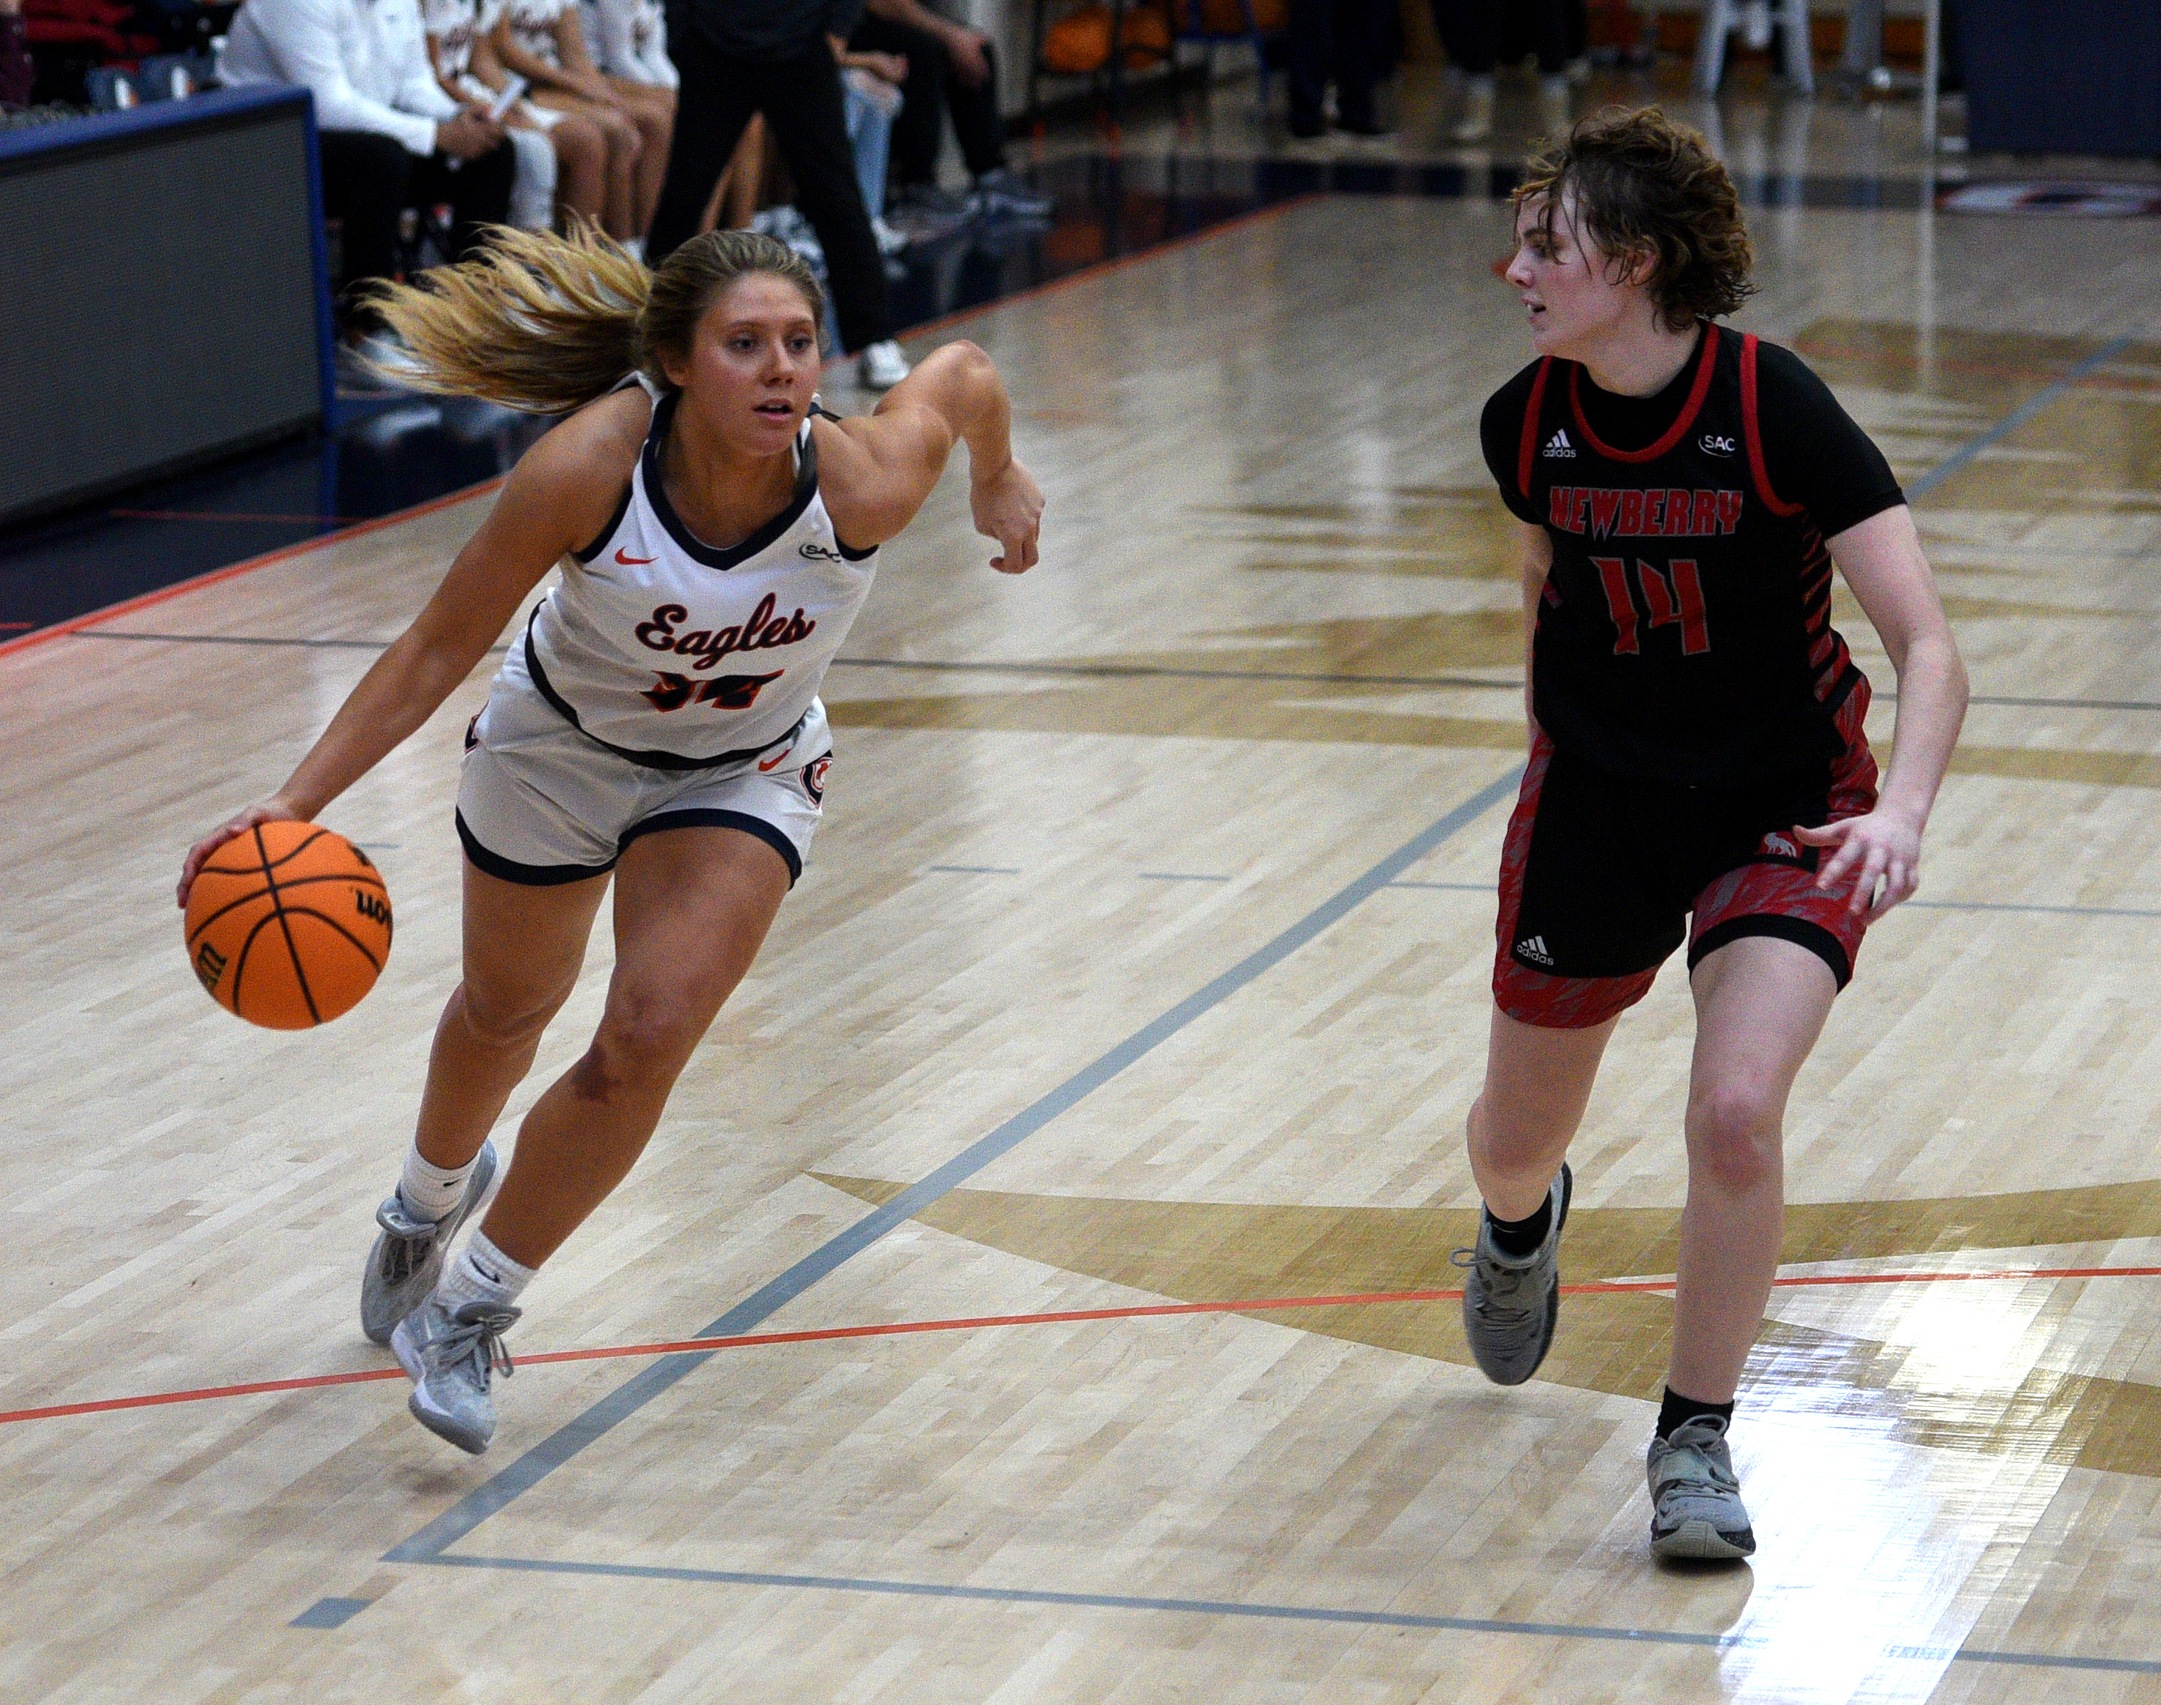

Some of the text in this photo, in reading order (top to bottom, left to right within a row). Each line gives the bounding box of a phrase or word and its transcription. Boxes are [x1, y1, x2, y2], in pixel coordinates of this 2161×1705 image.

[1542, 446, 1577, 459] adidas
[1704, 434, 1736, 452] SAC
[1550, 485, 1744, 541] NEWBERRY
[1588, 555, 1712, 656] 14
[634, 591, 817, 671] Eagles
[1516, 944, 1555, 966] adidas
